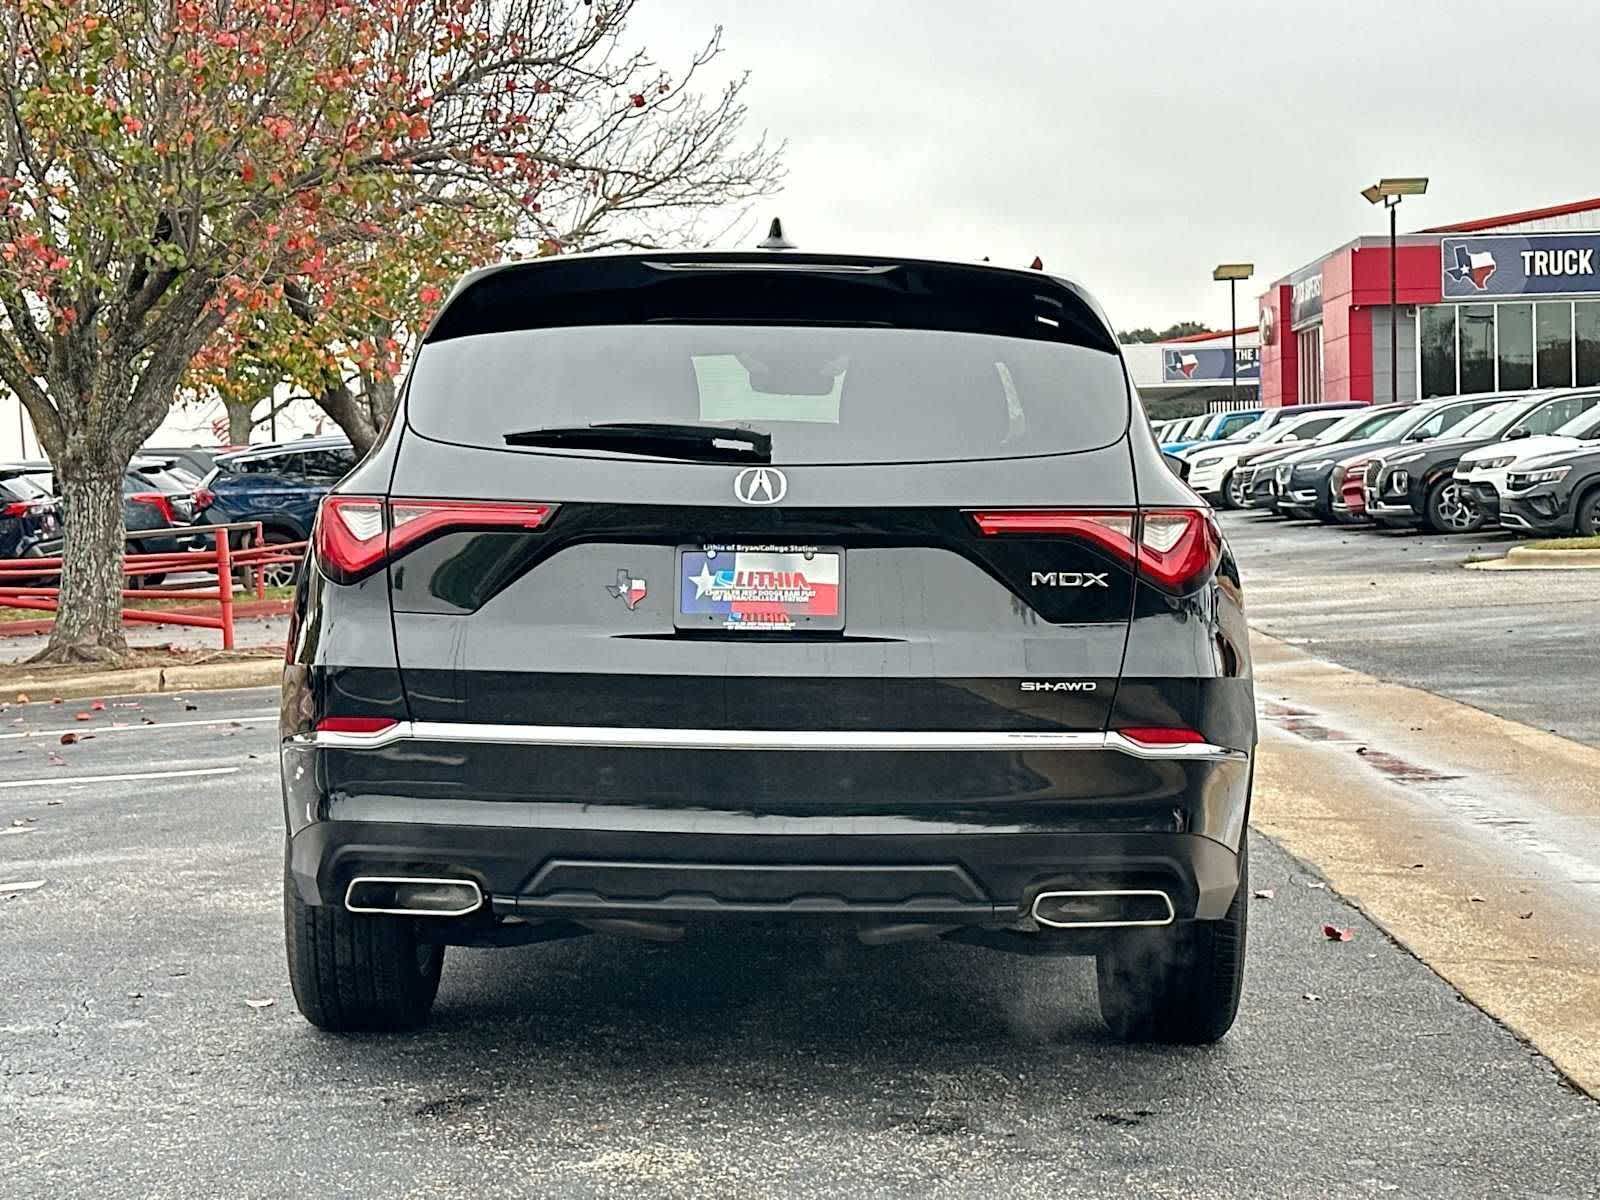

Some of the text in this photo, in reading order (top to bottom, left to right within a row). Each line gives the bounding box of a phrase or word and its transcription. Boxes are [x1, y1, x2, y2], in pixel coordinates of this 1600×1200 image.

[1520, 249, 1594, 276] TRUCK
[1235, 349, 1254, 361] THE
[737, 544, 788, 552] Bryan/College
[735, 571, 809, 588] LITHIA
[1031, 572, 1109, 587] MDX
[1020, 682, 1097, 691] SH-AWD
